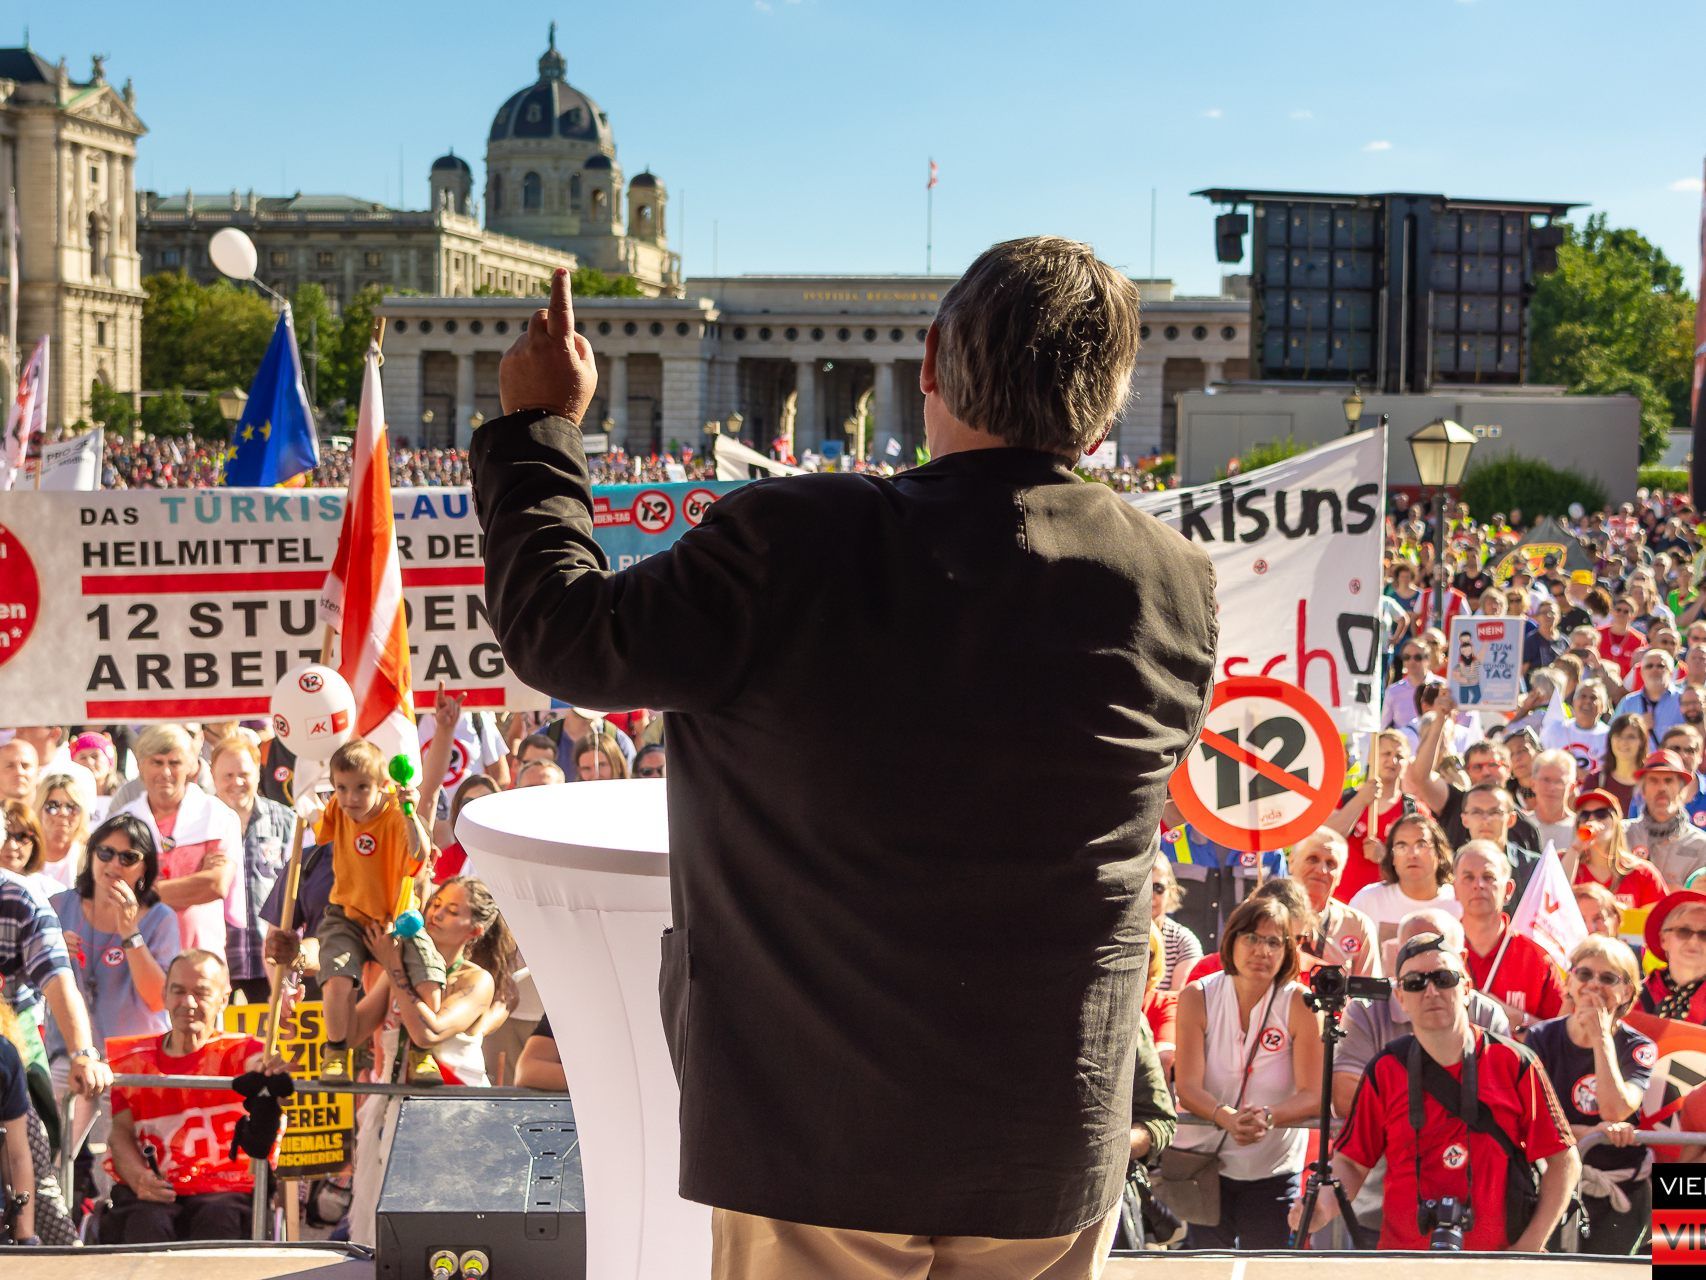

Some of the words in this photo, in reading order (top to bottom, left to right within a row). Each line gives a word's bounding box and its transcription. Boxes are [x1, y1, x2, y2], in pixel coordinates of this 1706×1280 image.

[80, 507, 139, 526] DAS
[160, 491, 343, 525] TÜRKIS
[641, 501, 668, 522] 12
[82, 537, 324, 567] HEILMITTEL
[86, 603, 160, 641] 12
[188, 594, 491, 640] STUEN
[1477, 626, 1503, 637] NEIN
[1493, 650, 1508, 664] 12
[1486, 668, 1512, 680] TAG
[1200, 716, 1309, 811] 12
[1265, 1033, 1281, 1046] 12
